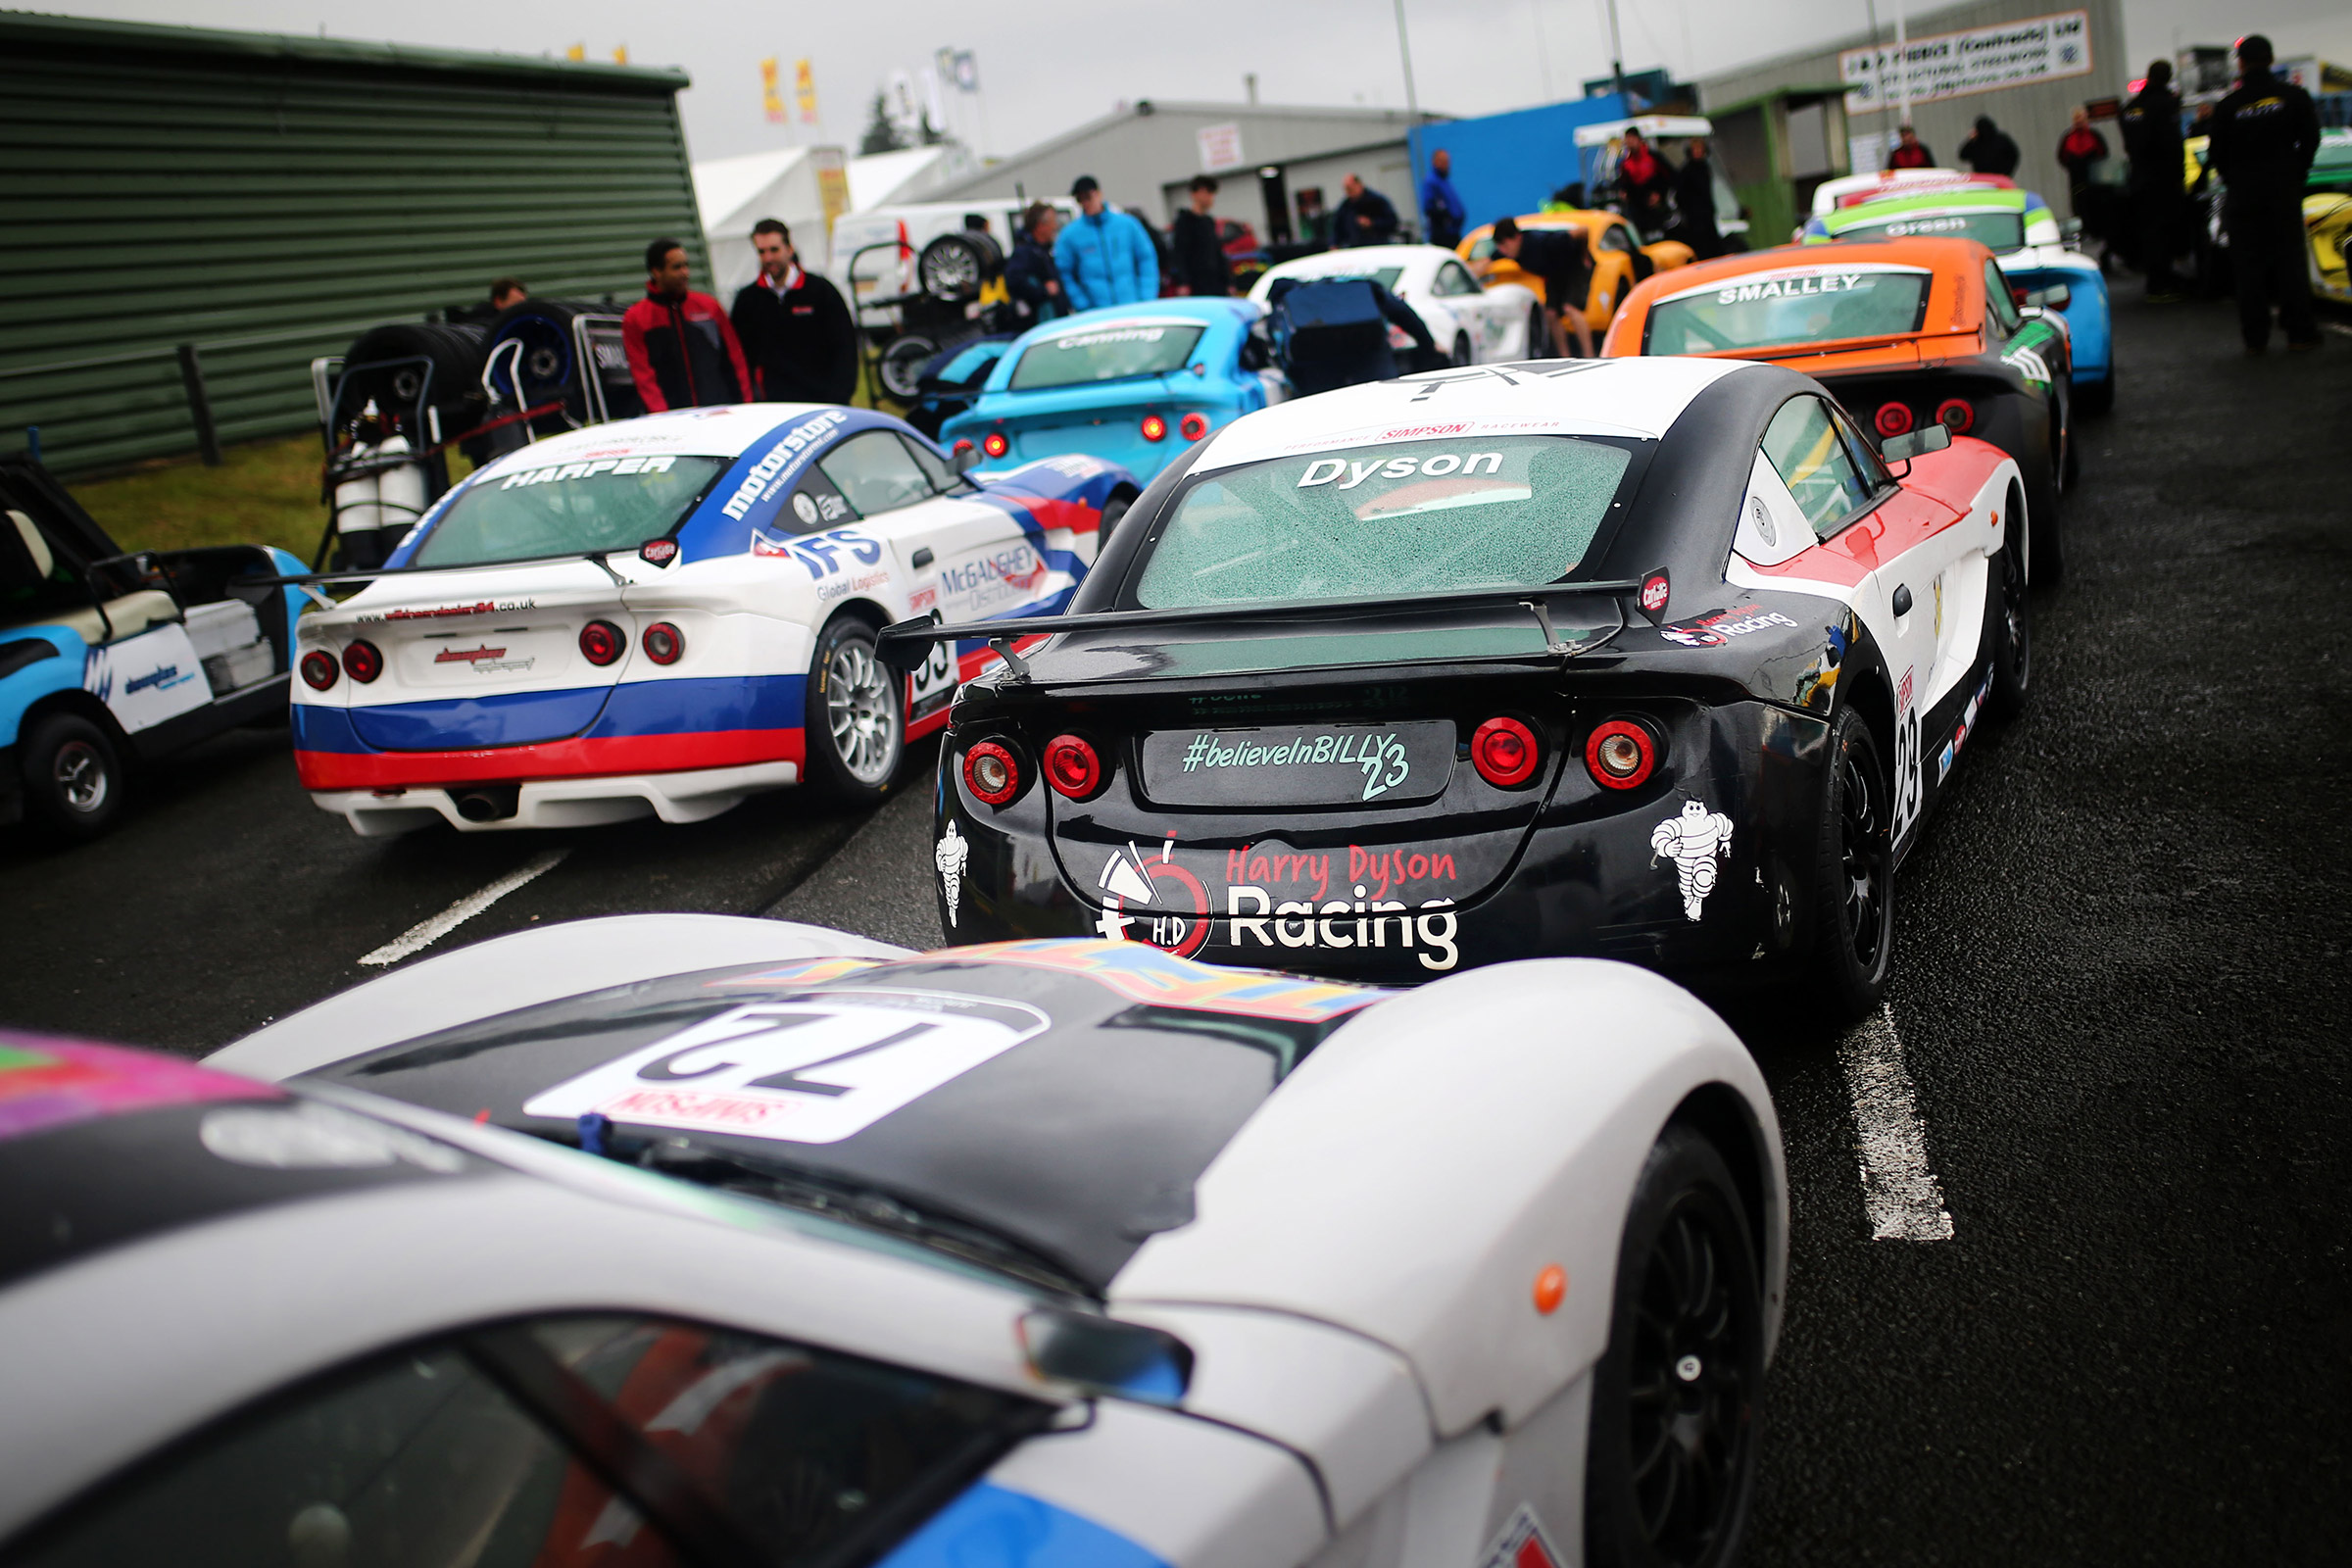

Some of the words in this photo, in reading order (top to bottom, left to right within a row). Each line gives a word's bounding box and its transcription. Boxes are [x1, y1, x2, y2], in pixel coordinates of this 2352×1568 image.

[1886, 218, 1966, 237] Green
[1718, 274, 1861, 306] SMALLEY
[1057, 328, 1165, 350] Canning
[1284, 434, 1371, 451] PERFORMANCE
[1381, 423, 1468, 440] SIMPSON
[501, 457, 676, 491] HARPER
[721, 410, 848, 521] motorstore
[1297, 452, 1504, 490] Dyson
[795, 531, 881, 580] IFS
[817, 578, 850, 601] Global
[1710, 612, 1798, 637] Racing
[1361, 743, 1409, 801] 23
[1226, 845, 1330, 902] Harry
[1348, 844, 1456, 902] Dyson
[1227, 884, 1458, 971] Racing
[636, 1012, 944, 1098] 72
[612, 1090, 786, 1124] SIMPSON
